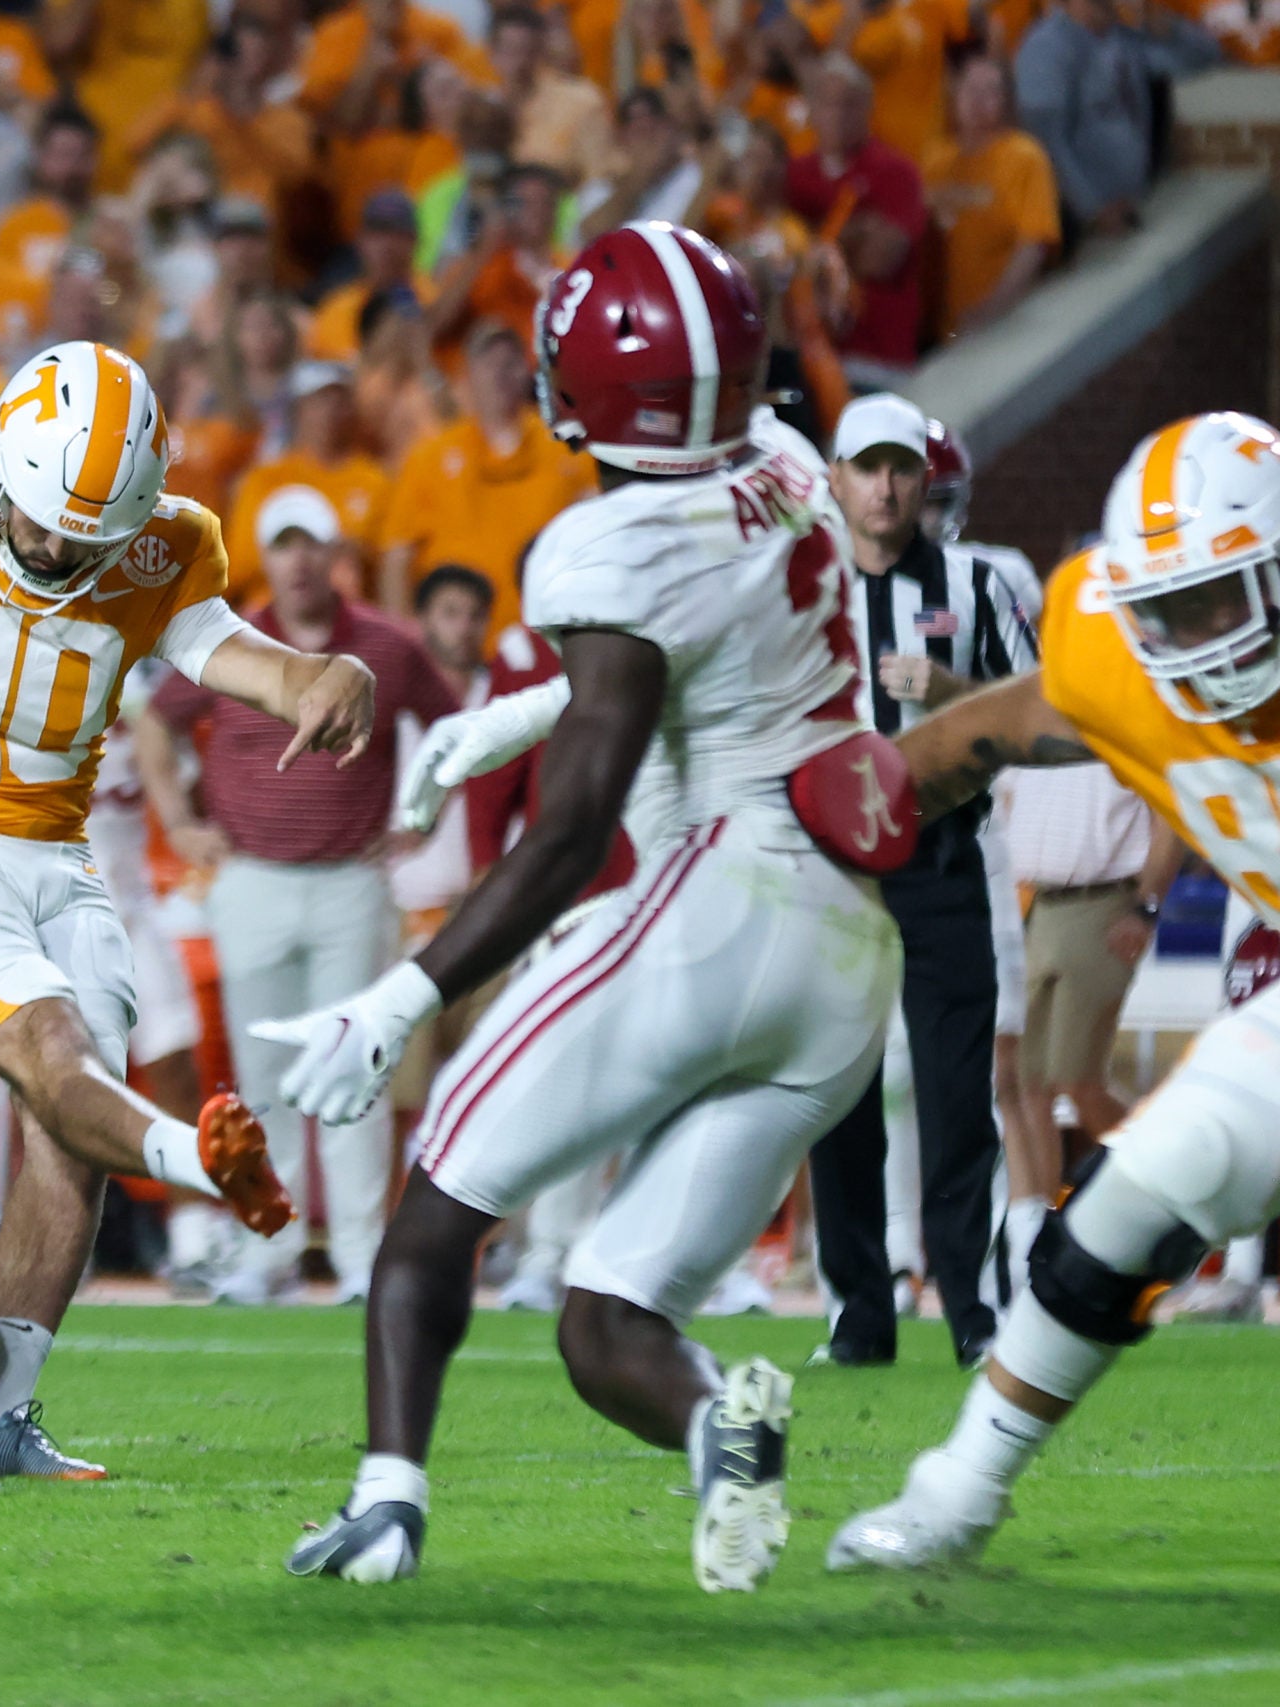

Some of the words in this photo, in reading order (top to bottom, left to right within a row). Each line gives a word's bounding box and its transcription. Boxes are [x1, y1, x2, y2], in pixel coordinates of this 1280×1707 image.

[552, 267, 594, 337] 3
[58, 514, 98, 535] VOLS
[133, 535, 170, 573] SEC
[21, 572, 52, 588] Riddell
